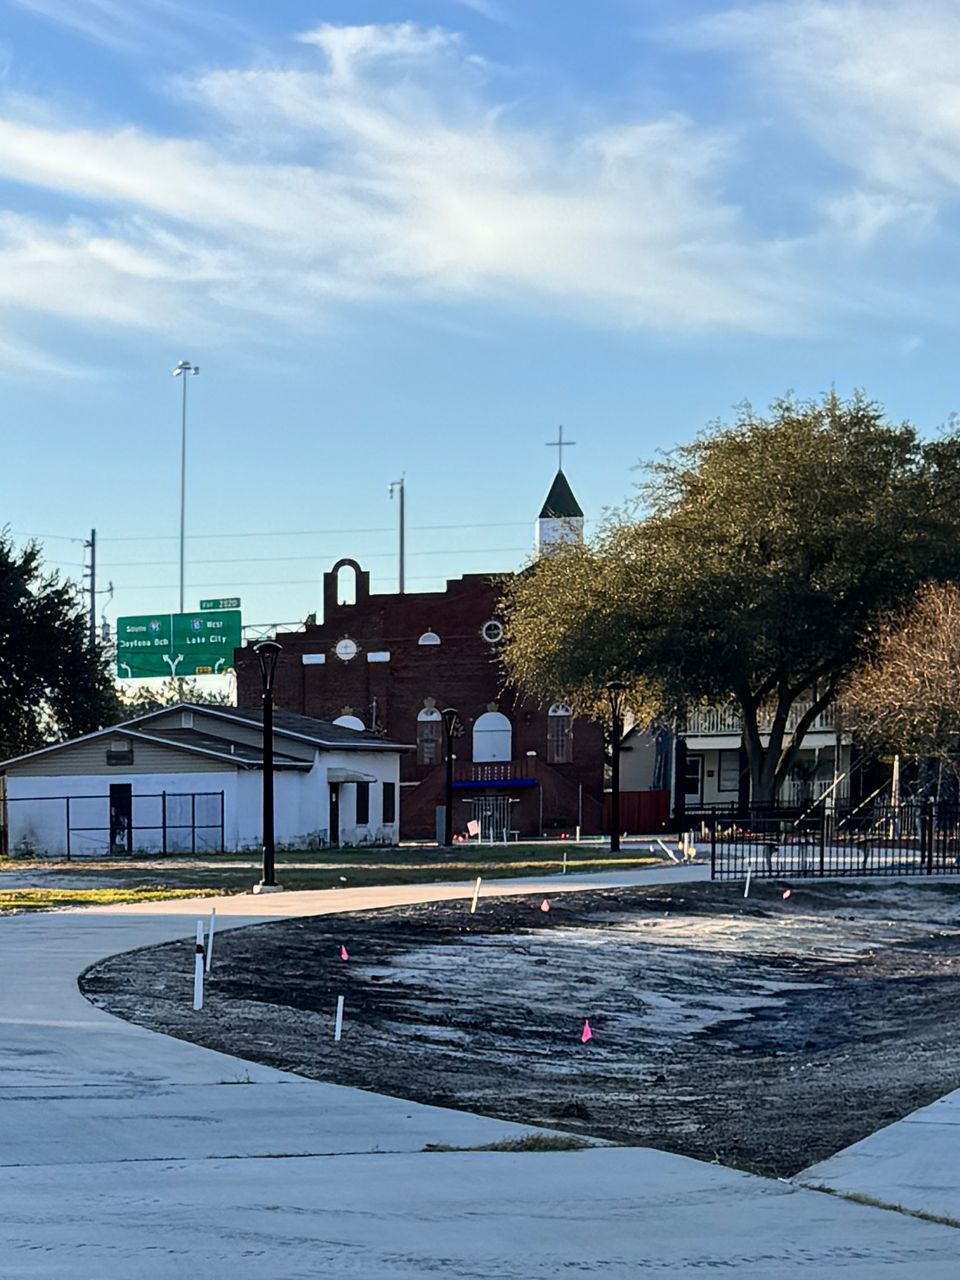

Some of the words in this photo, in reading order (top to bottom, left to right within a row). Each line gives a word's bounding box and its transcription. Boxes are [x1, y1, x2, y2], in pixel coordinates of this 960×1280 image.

[186, 636, 205, 644] Lake
[209, 635, 227, 644] City
[119, 640, 150, 648] Daytona
